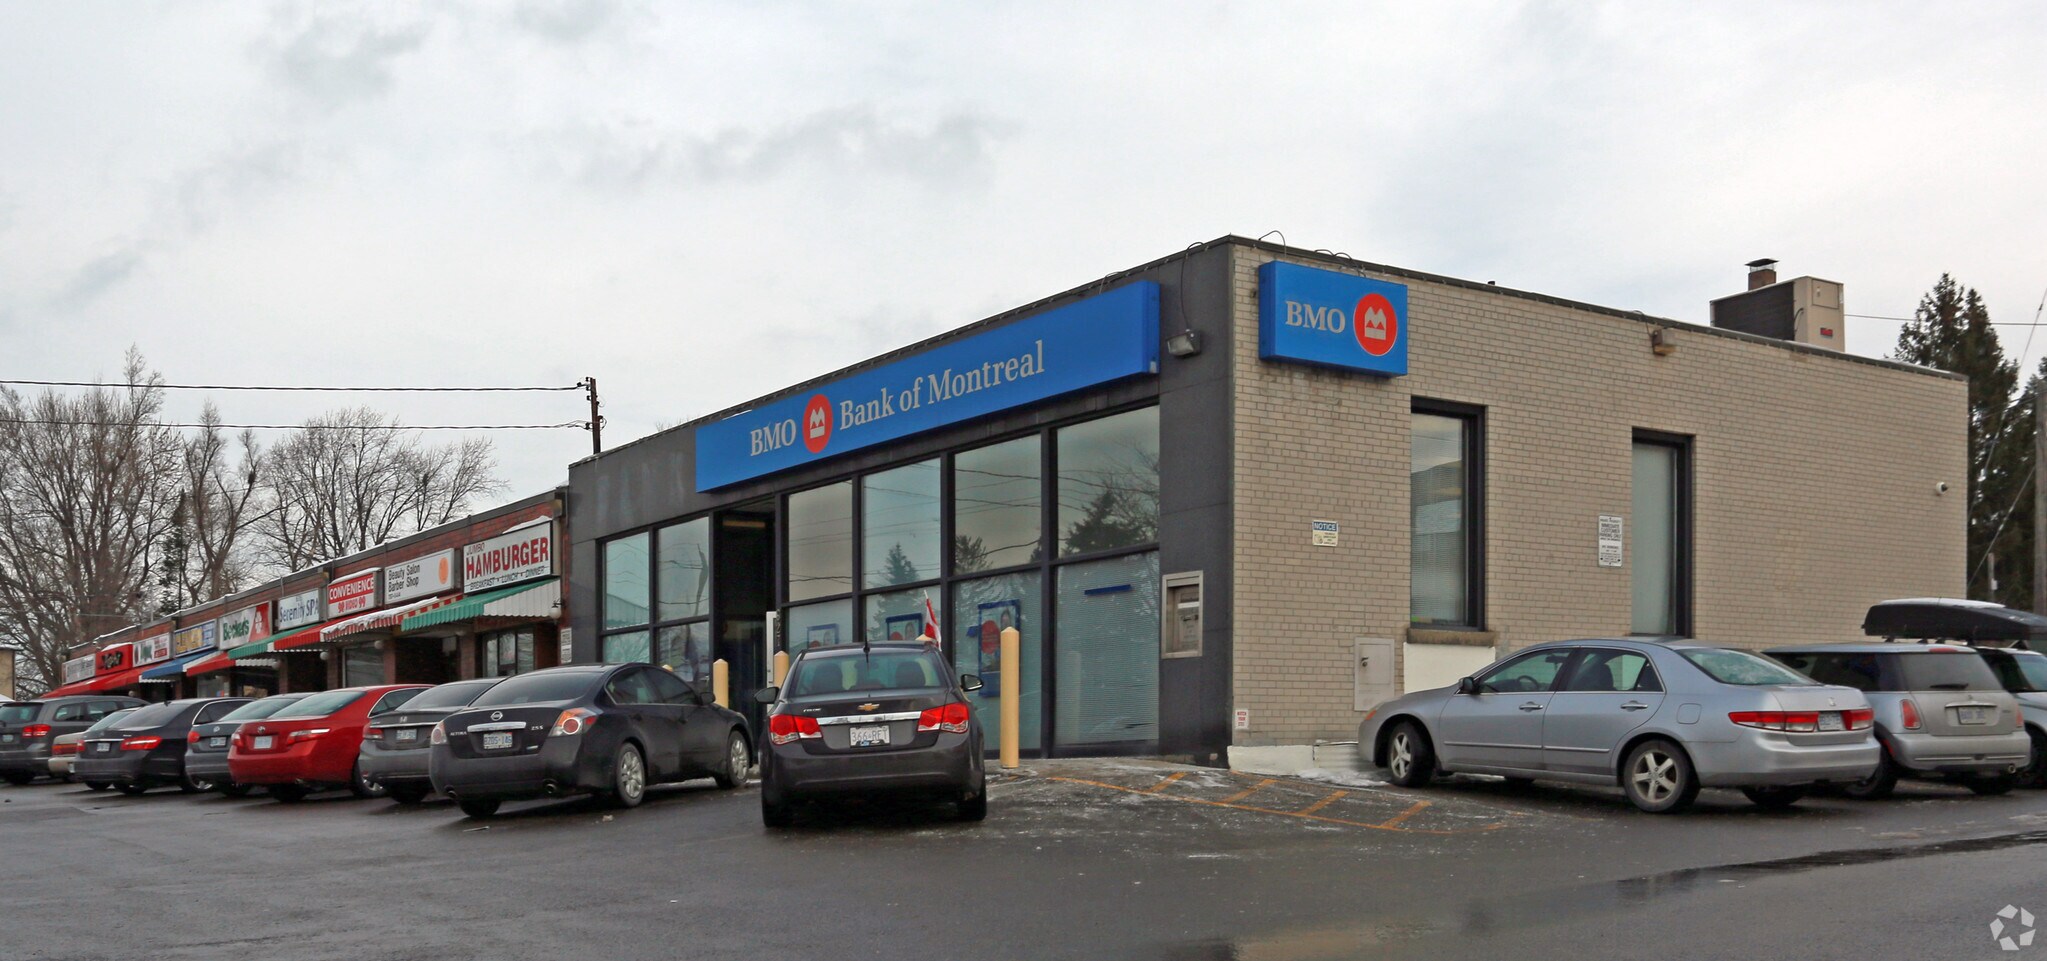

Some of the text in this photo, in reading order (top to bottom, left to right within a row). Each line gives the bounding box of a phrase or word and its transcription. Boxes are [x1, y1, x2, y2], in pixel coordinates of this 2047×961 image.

[1285, 300, 1346, 334] BMO
[750, 339, 1045, 457] BMO Bank of Montreal
[1314, 522, 1336, 531] NOTICE
[466, 542, 486, 555] JUMBO
[466, 537, 549, 580] HAMBURGER
[388, 563, 420, 581] Beauty Salon
[329, 577, 374, 600] CONVENIENCE
[388, 576, 419, 592] Barber Shop
[280, 601, 305, 623] Serenity
